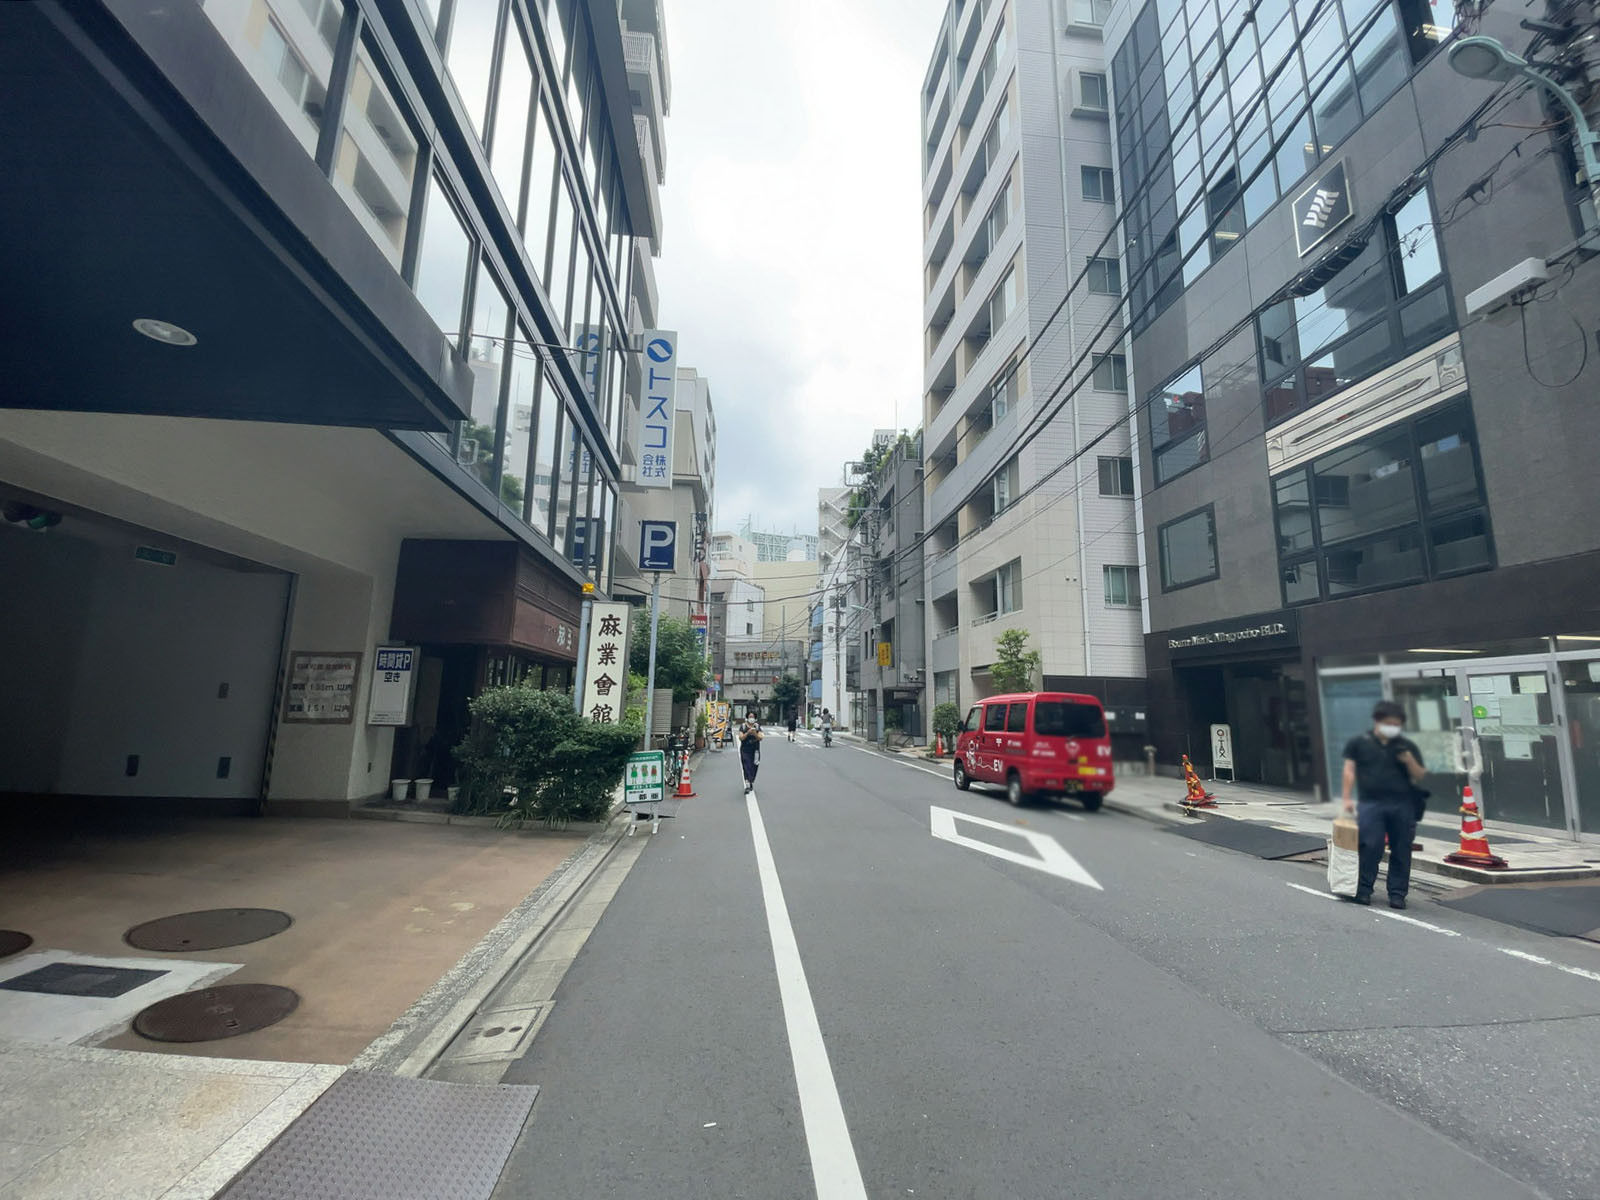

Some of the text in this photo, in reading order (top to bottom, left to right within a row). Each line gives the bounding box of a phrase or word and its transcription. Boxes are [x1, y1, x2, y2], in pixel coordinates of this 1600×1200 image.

[644, 368, 671, 449] トスコ
[643, 524, 674, 558] P
[384, 672, 401, 683] 空き
[589, 614, 623, 724] 麻業會館
[1097, 745, 1111, 757] EV
[993, 759, 1004, 773] EV
